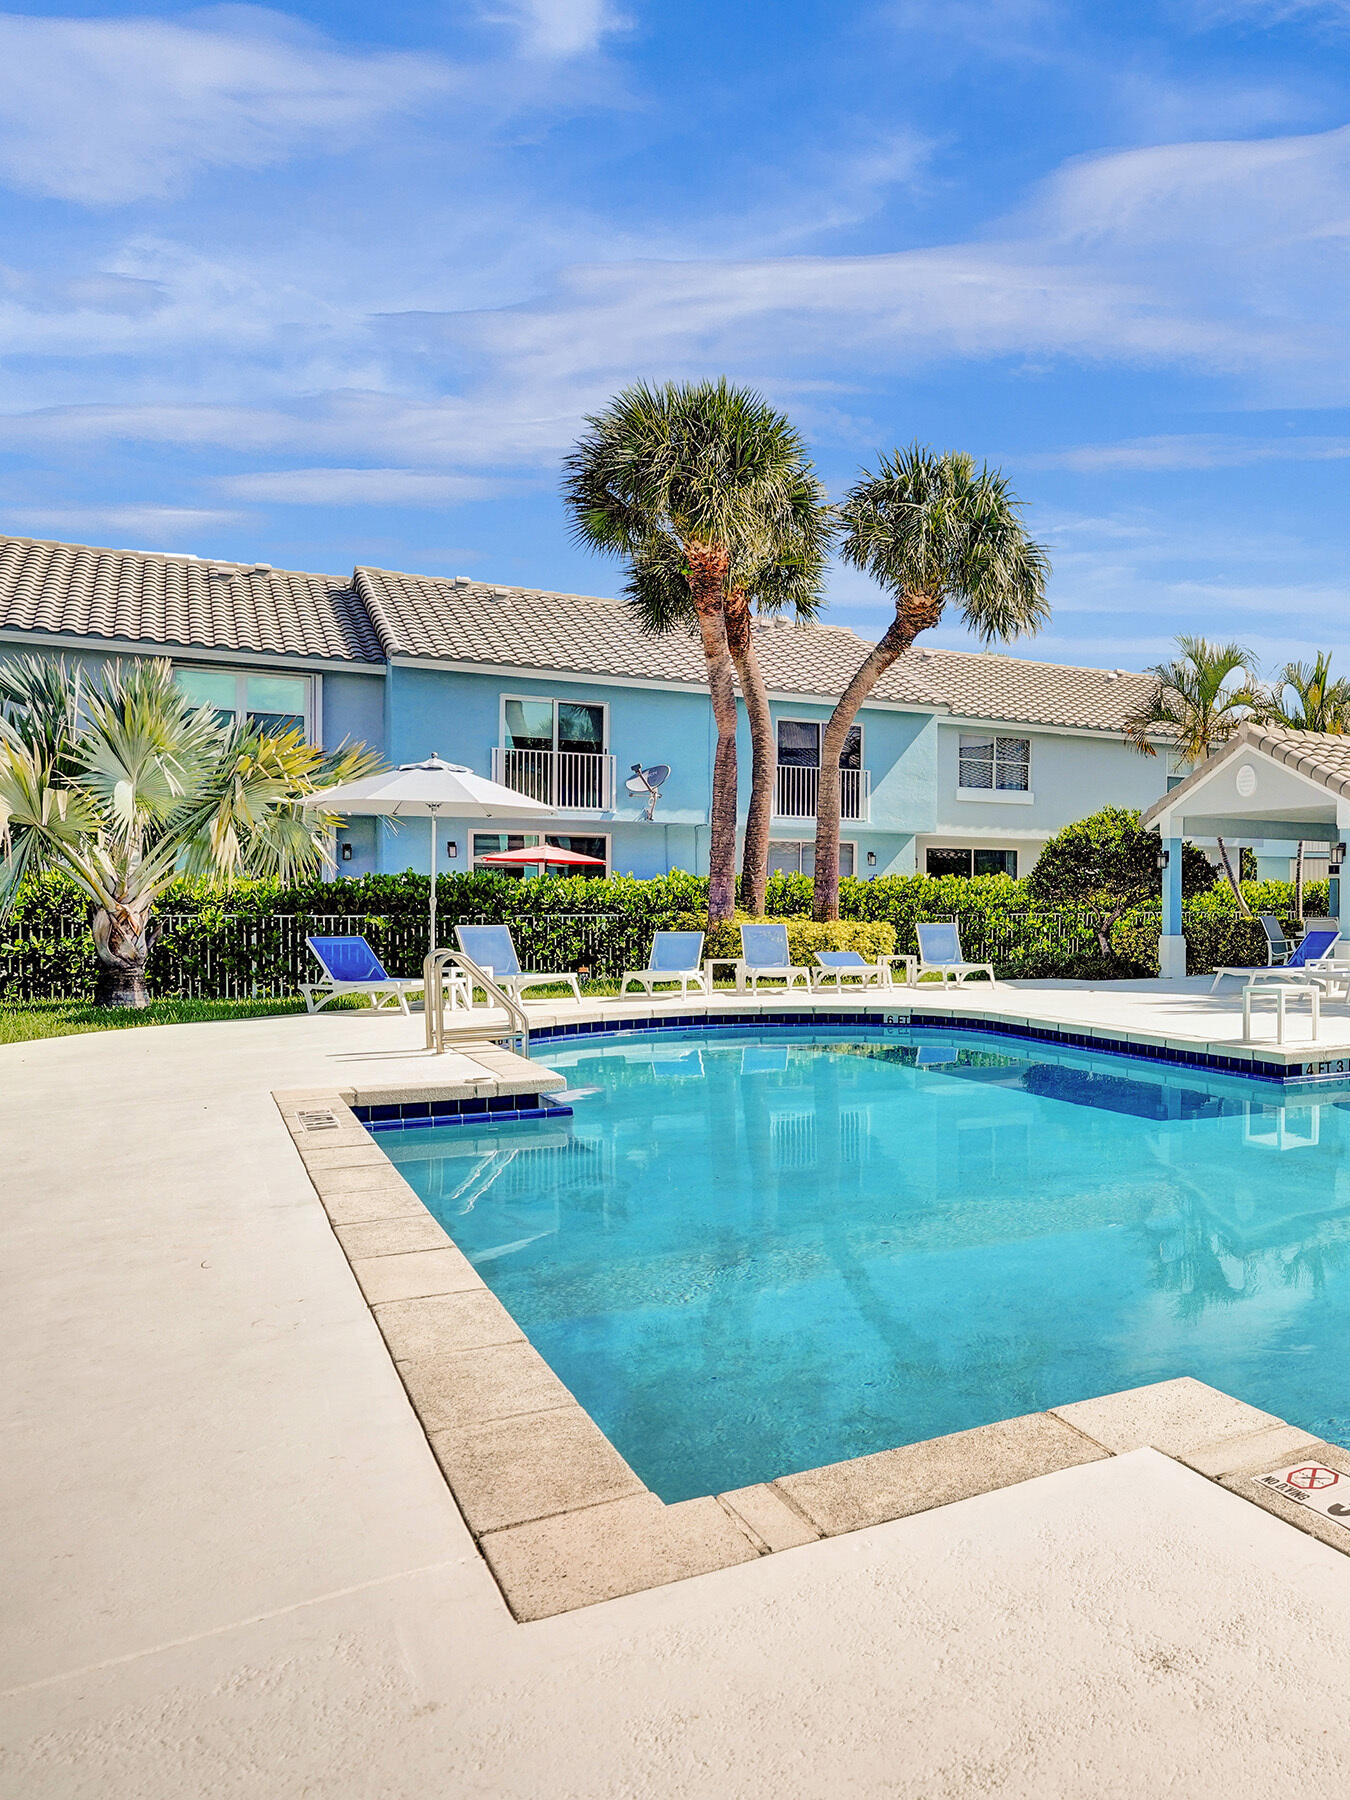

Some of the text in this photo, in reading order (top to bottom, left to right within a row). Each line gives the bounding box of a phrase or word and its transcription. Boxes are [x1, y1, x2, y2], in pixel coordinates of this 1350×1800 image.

[887, 1015, 910, 1025] 6 FT
[1306, 1062, 1313, 1074] 4
[1318, 1061, 1331, 1073] FT
[1336, 1060, 1343, 1072] 3
[1260, 1475, 1280, 1485] NO
